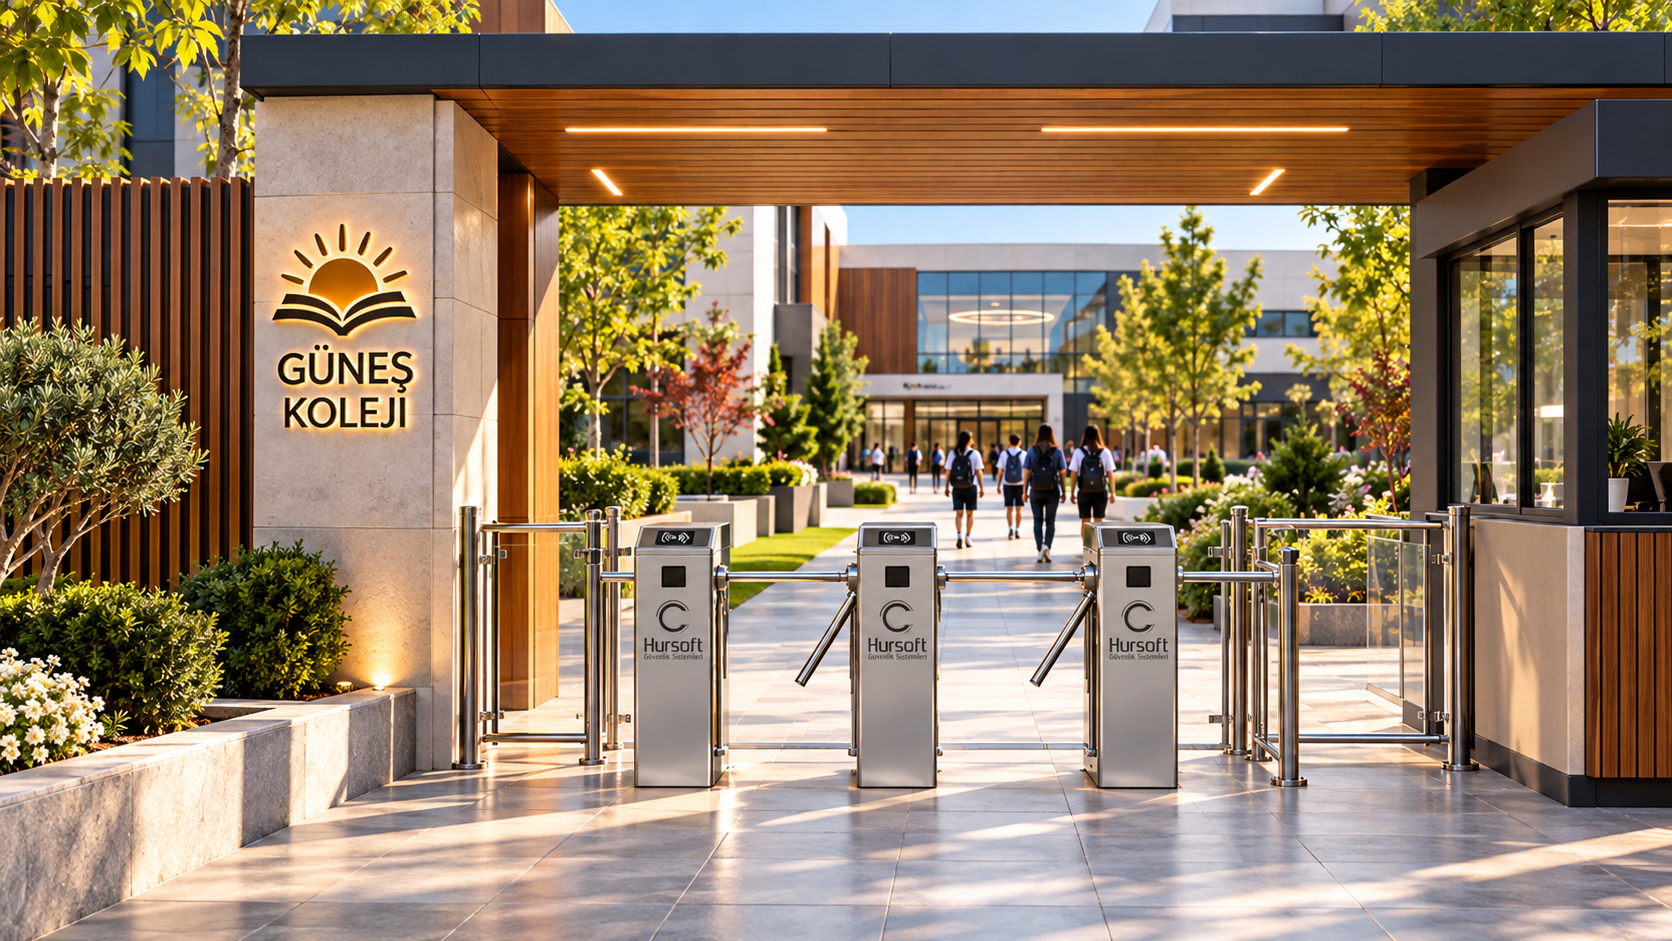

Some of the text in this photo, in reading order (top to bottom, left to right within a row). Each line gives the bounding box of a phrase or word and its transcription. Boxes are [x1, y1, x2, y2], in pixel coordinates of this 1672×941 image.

[278, 344, 414, 394] GÜNEŞ
[644, 637, 703, 653] Hursoft
[868, 637, 927, 653] Hursoft
[1109, 637, 1168, 653] Hursoft
